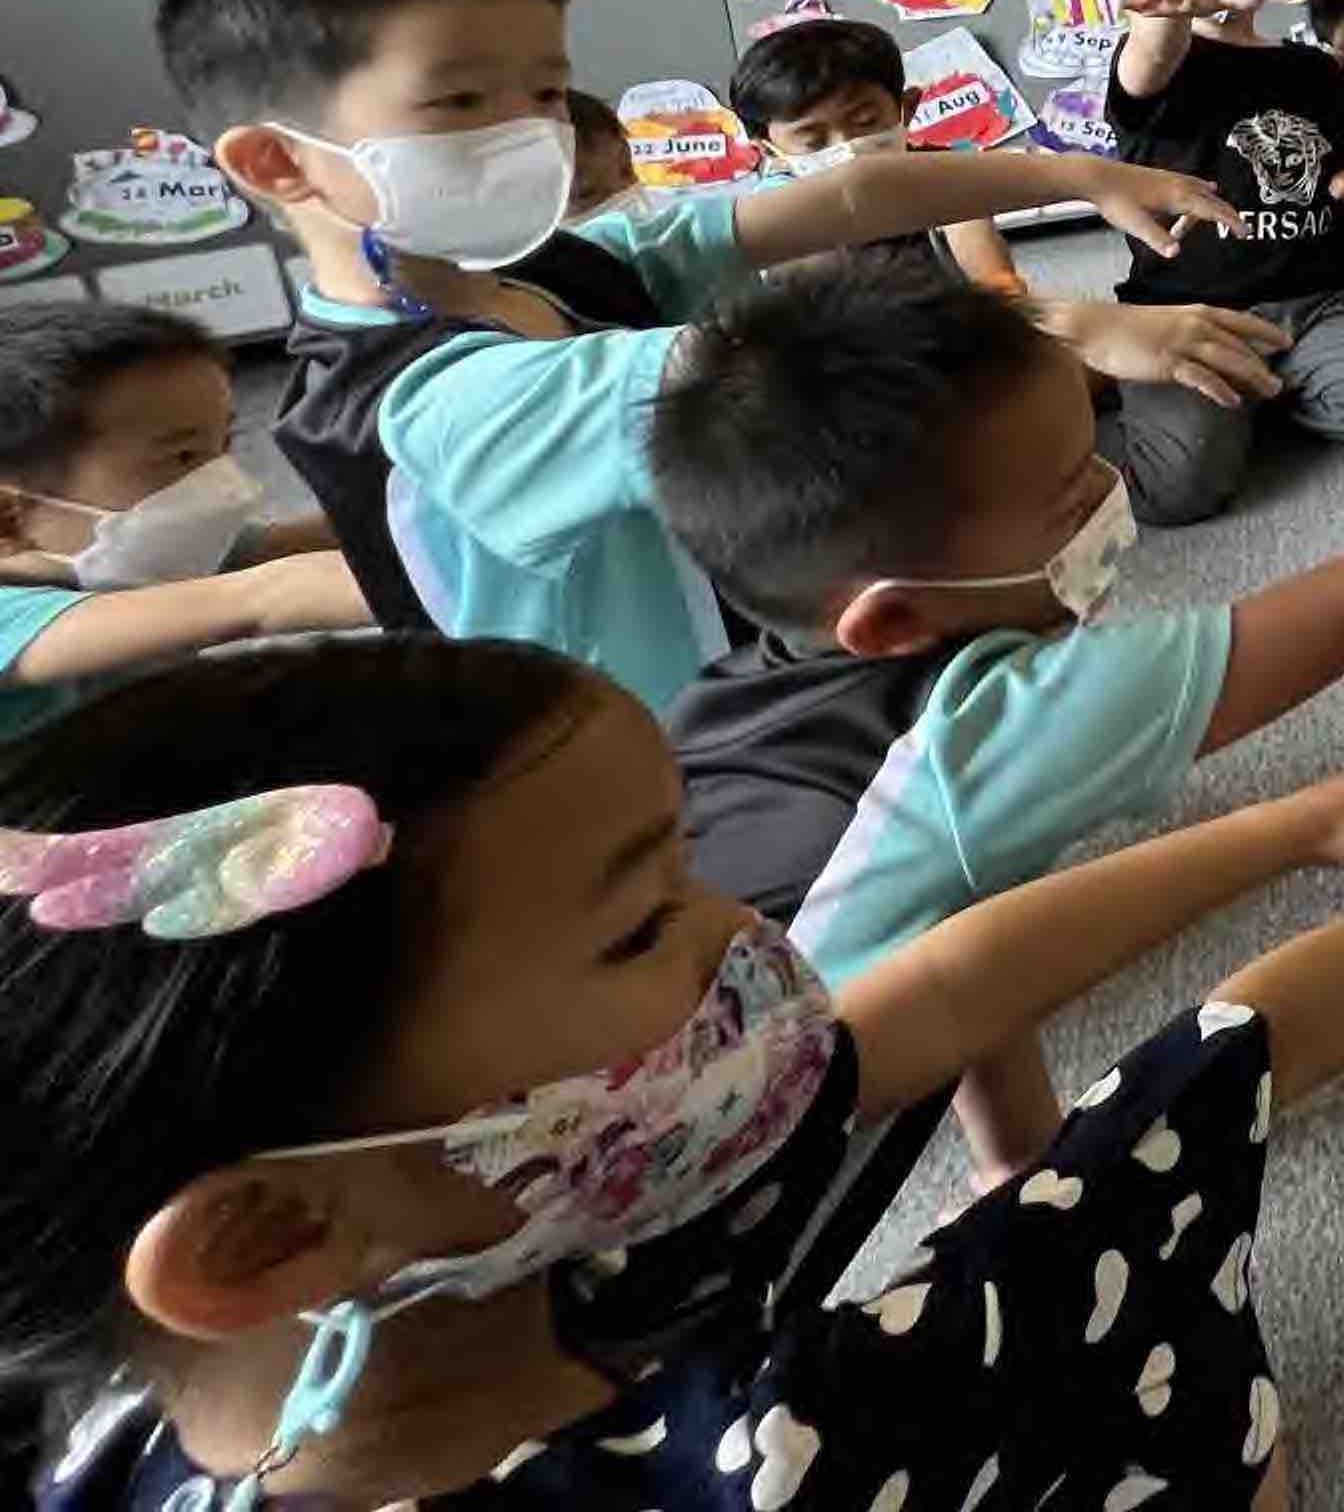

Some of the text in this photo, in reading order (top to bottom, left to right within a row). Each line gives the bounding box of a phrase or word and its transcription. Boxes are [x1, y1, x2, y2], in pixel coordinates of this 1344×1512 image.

[1074, 31, 1113, 51] Sep
[938, 90, 980, 115] Aug
[663, 138, 721, 154] June
[1216, 207, 1333, 240] VERSAC
